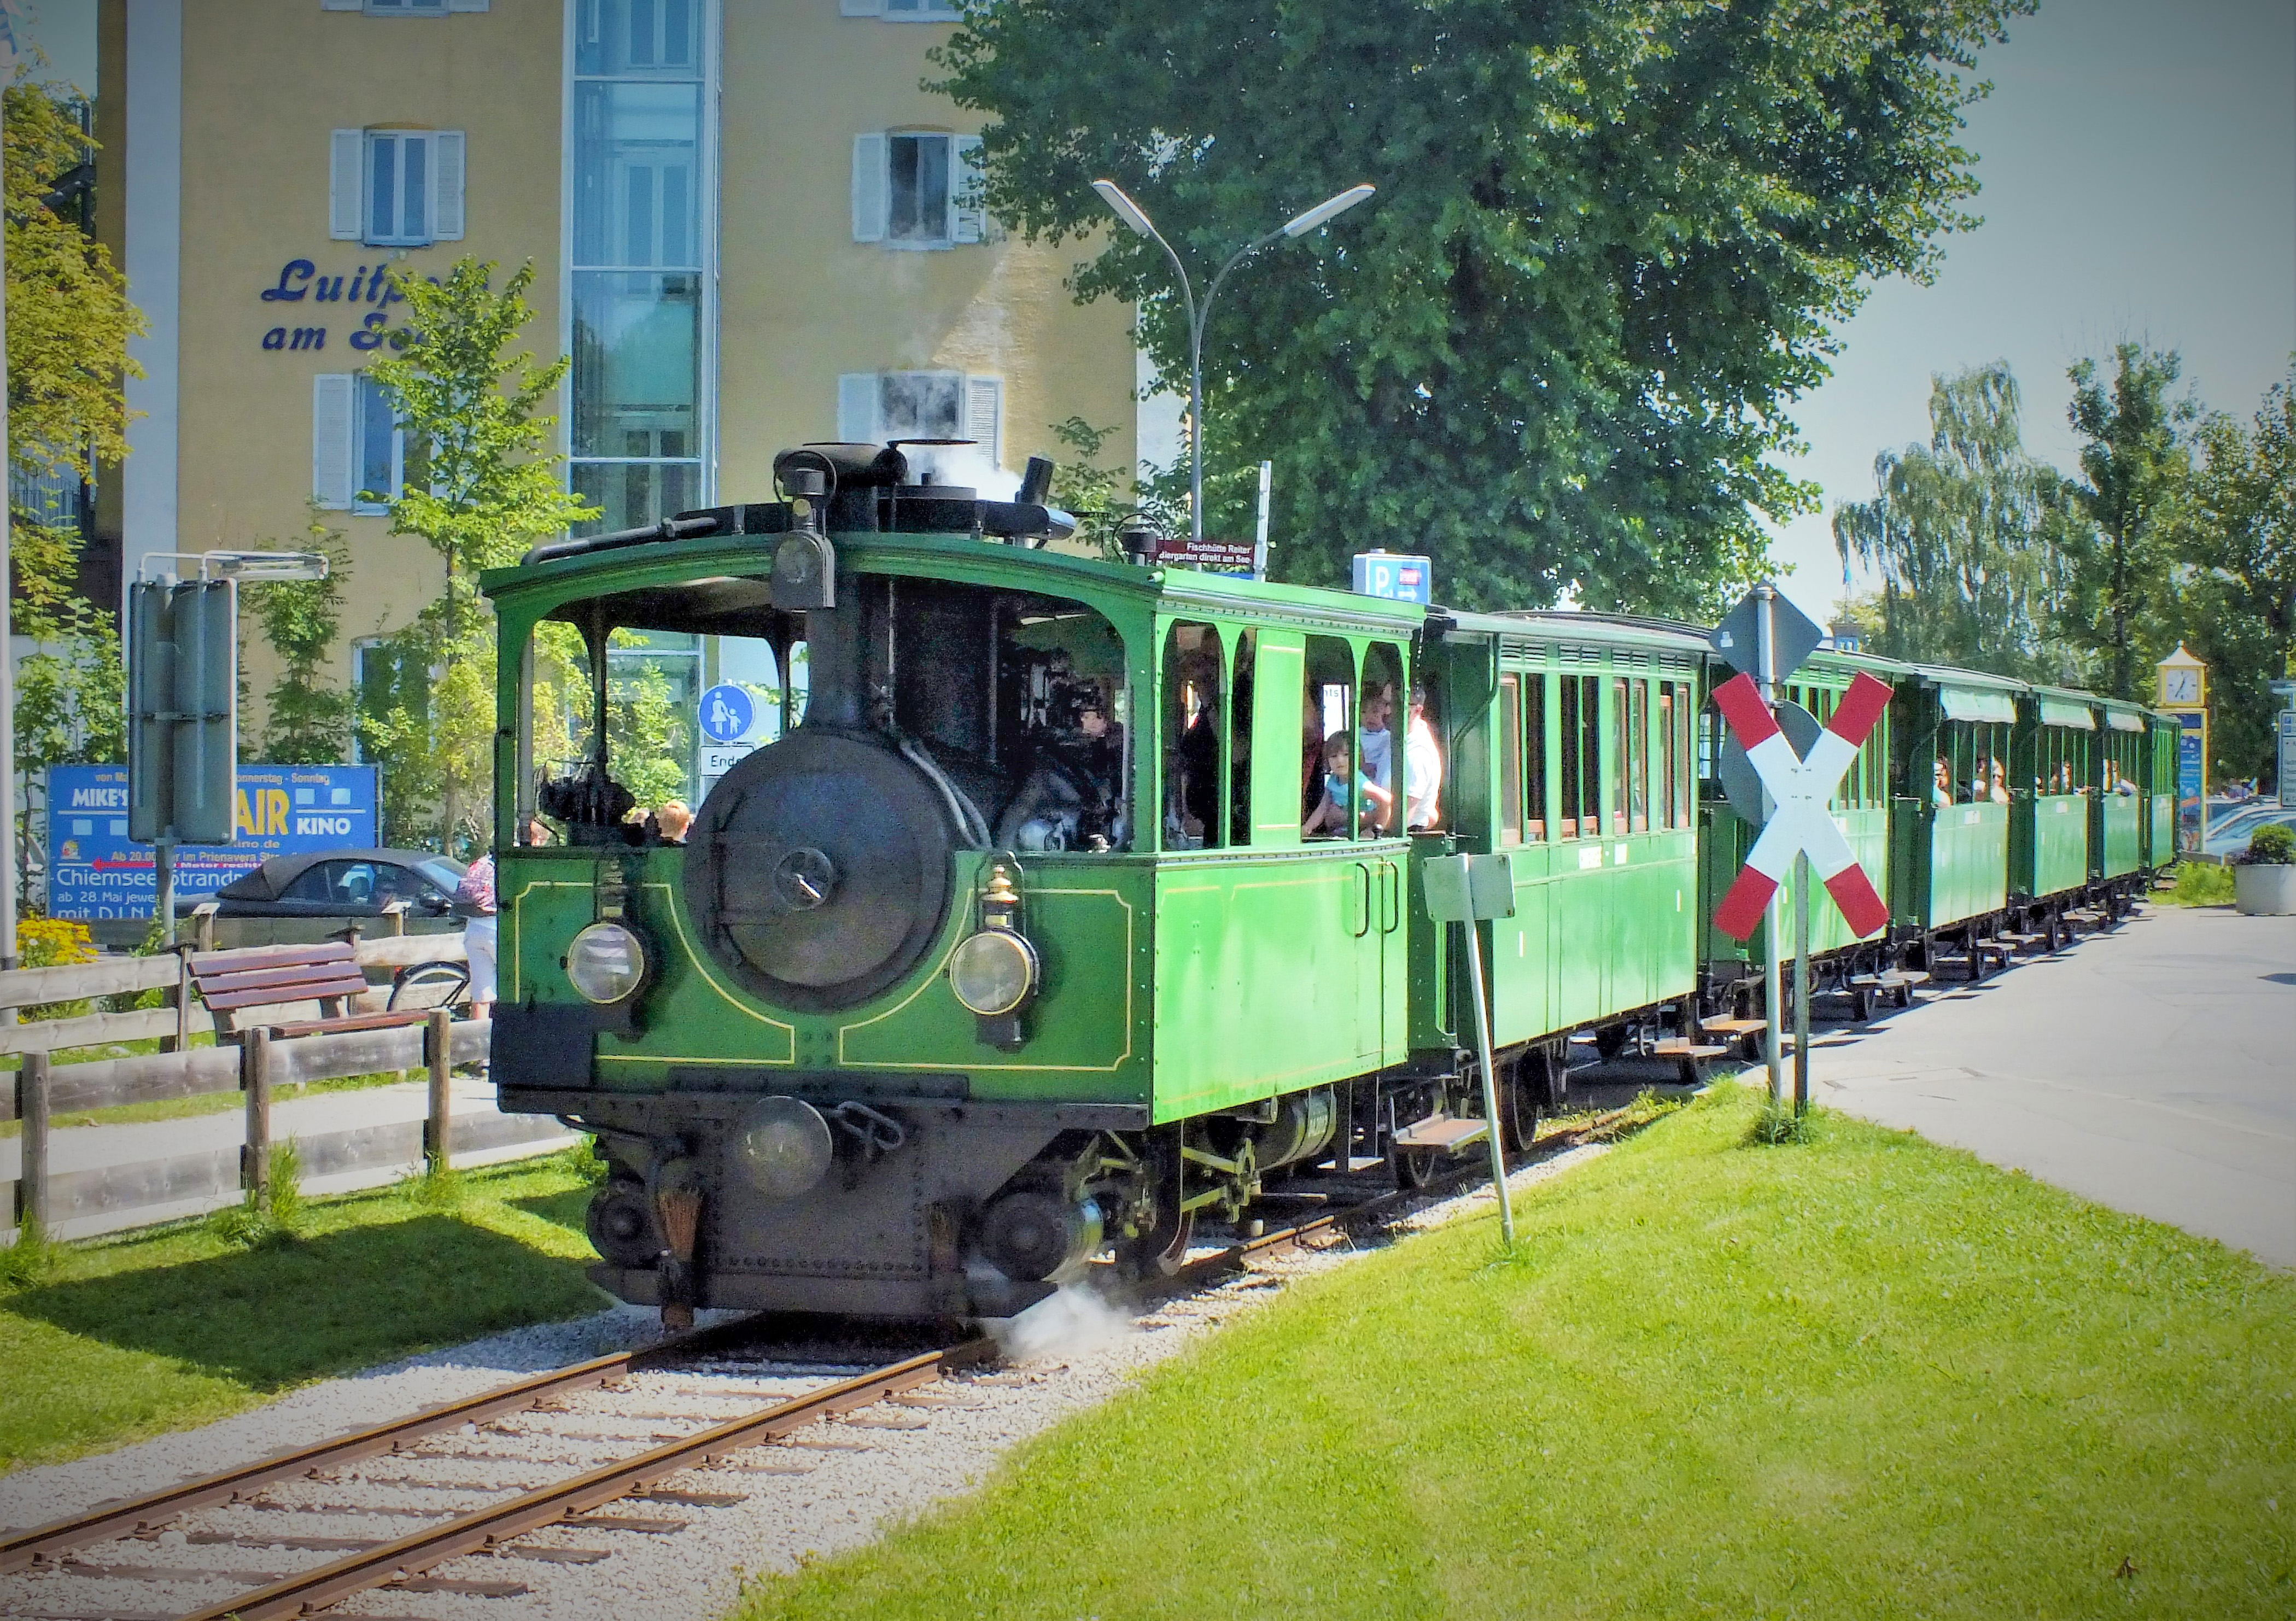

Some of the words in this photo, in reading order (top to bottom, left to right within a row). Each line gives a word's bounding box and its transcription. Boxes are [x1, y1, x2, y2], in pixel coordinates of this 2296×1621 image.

[262, 327, 326, 350] am
[349, 312, 432, 350] Se
[1228, 545, 1252, 554] Reiter
[1199, 553, 1221, 562] direkt
[1236, 555, 1251, 564] See
[237, 788, 290, 835] AIR
[297, 817, 351, 835] KINO
[111, 851, 126, 861] Ab
[183, 852, 196, 861] im
[57, 869, 156, 886] Chiemsee
[58, 892, 73, 902] ab
[103, 892, 122, 902] Mai
[57, 906, 91, 919] mit
